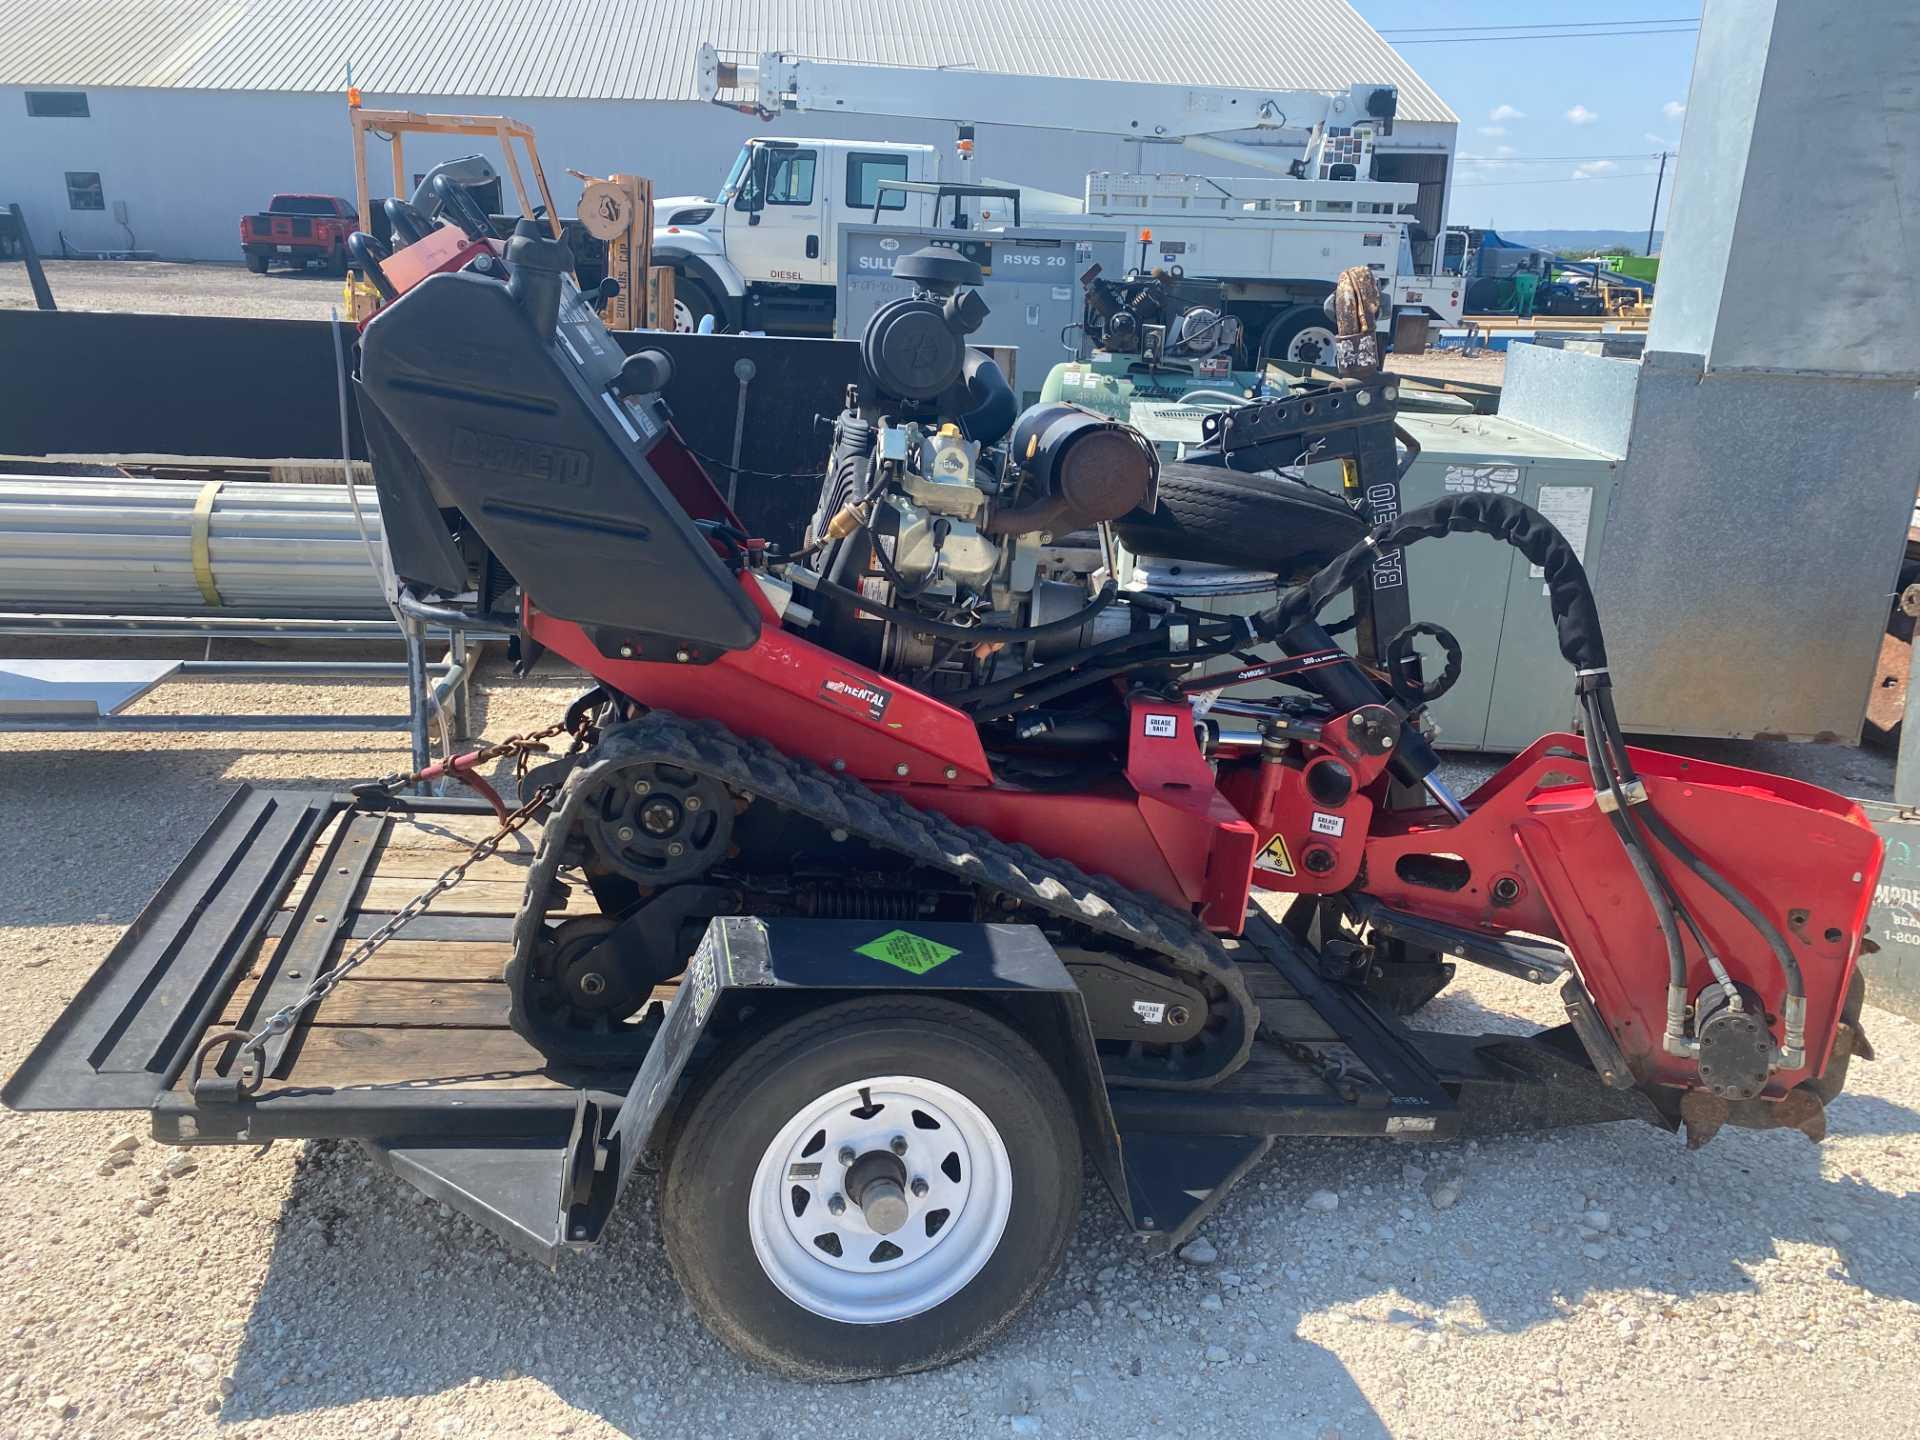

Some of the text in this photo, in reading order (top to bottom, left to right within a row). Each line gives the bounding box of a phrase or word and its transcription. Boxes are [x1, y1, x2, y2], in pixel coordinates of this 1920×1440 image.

[1003, 254, 1066, 267] RSVS 20
[770, 270, 803, 281] DIESEL
[843, 684, 885, 708] RENTAL
[1150, 718, 1172, 727] GREASE
[1152, 725, 1169, 733] DAILY
